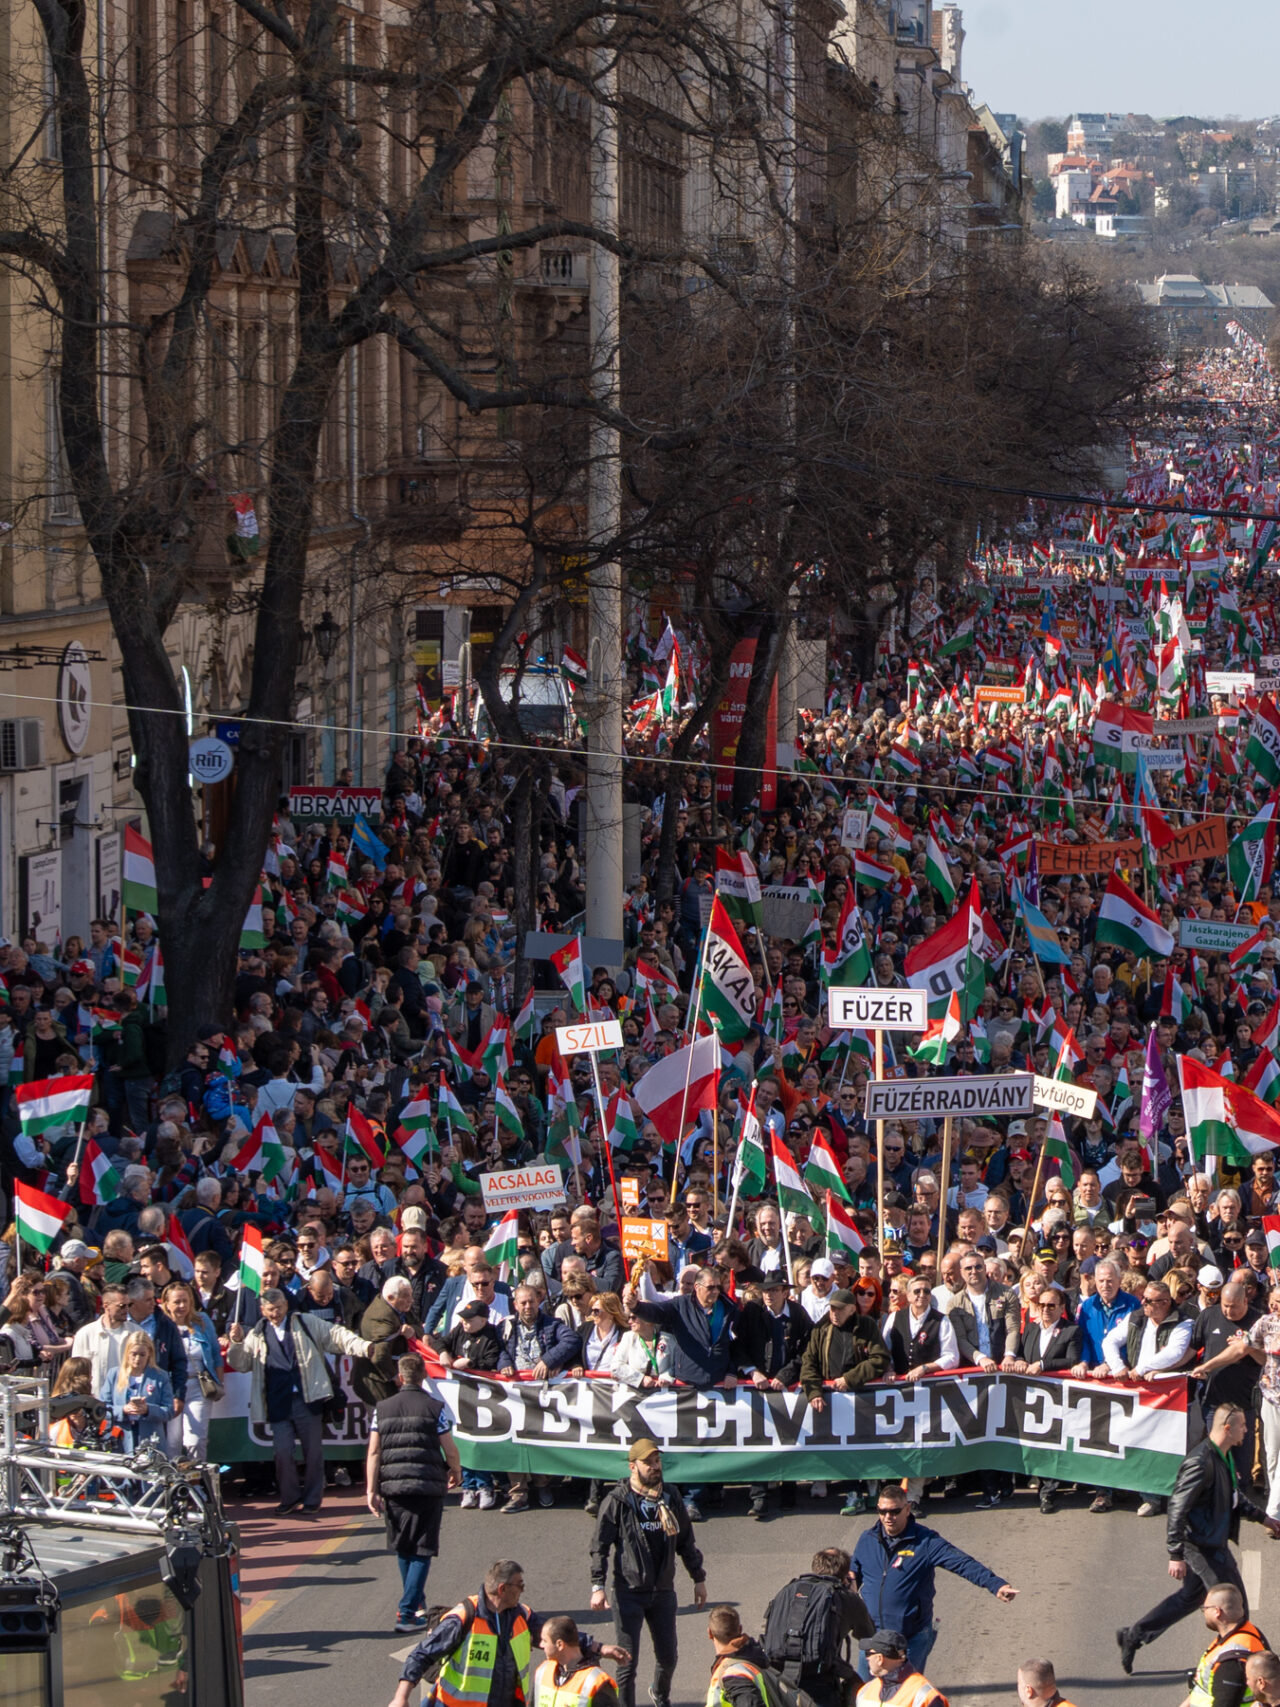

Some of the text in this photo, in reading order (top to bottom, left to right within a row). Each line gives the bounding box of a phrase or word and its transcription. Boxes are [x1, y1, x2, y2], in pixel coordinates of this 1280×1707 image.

[292, 790, 378, 816] IBRÁNY
[1038, 825, 1217, 873] FEHÉRGYRMAT
[1187, 924, 1250, 939] Jászkarajenő
[843, 994, 912, 1021] FÜZÉR
[565, 1025, 615, 1050] SZIL
[872, 1081, 1029, 1113] FÜZÉRRADVÁNY
[1032, 1084, 1086, 1111] évfülöp
[487, 1169, 556, 1191] ACSALAG
[485, 1195, 521, 1208] VELETEK
[469, 1648, 491, 1664] 544
